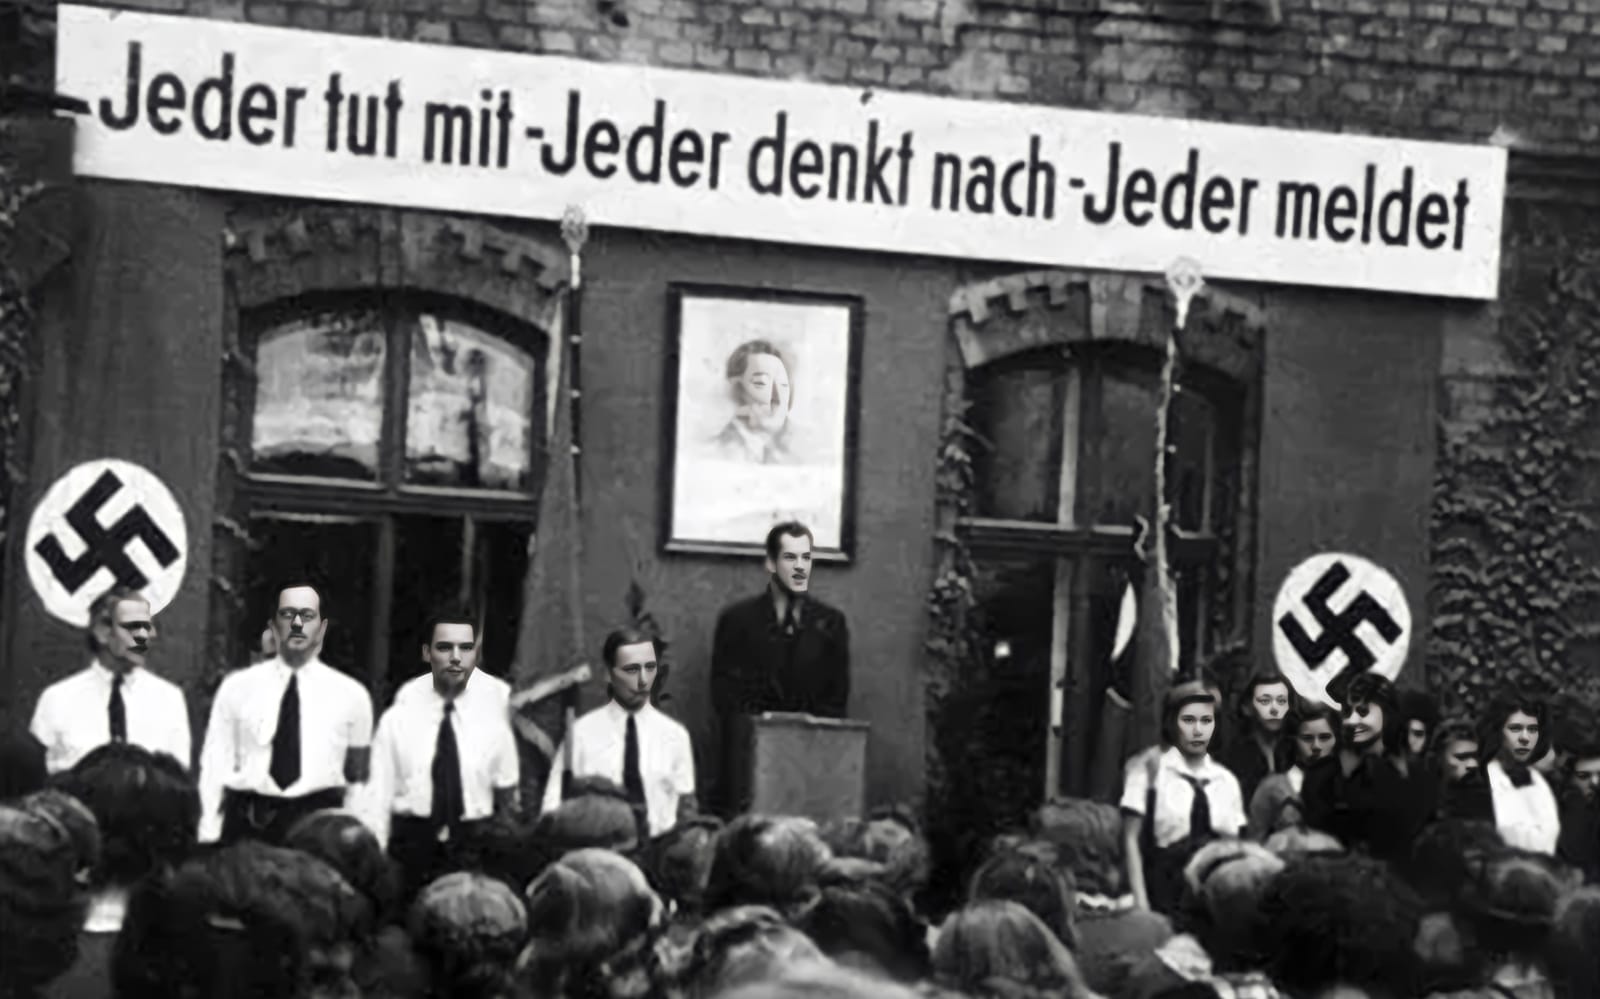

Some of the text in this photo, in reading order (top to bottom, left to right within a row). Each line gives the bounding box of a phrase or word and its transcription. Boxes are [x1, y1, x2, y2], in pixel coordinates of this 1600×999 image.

[100, 41, 307, 148] Jeder
[325, 73, 402, 158] tut
[424, 89, 514, 169] mit
[749, 111, 914, 206] denkt
[932, 135, 1056, 220] nach
[1276, 163, 1470, 251] meldet
